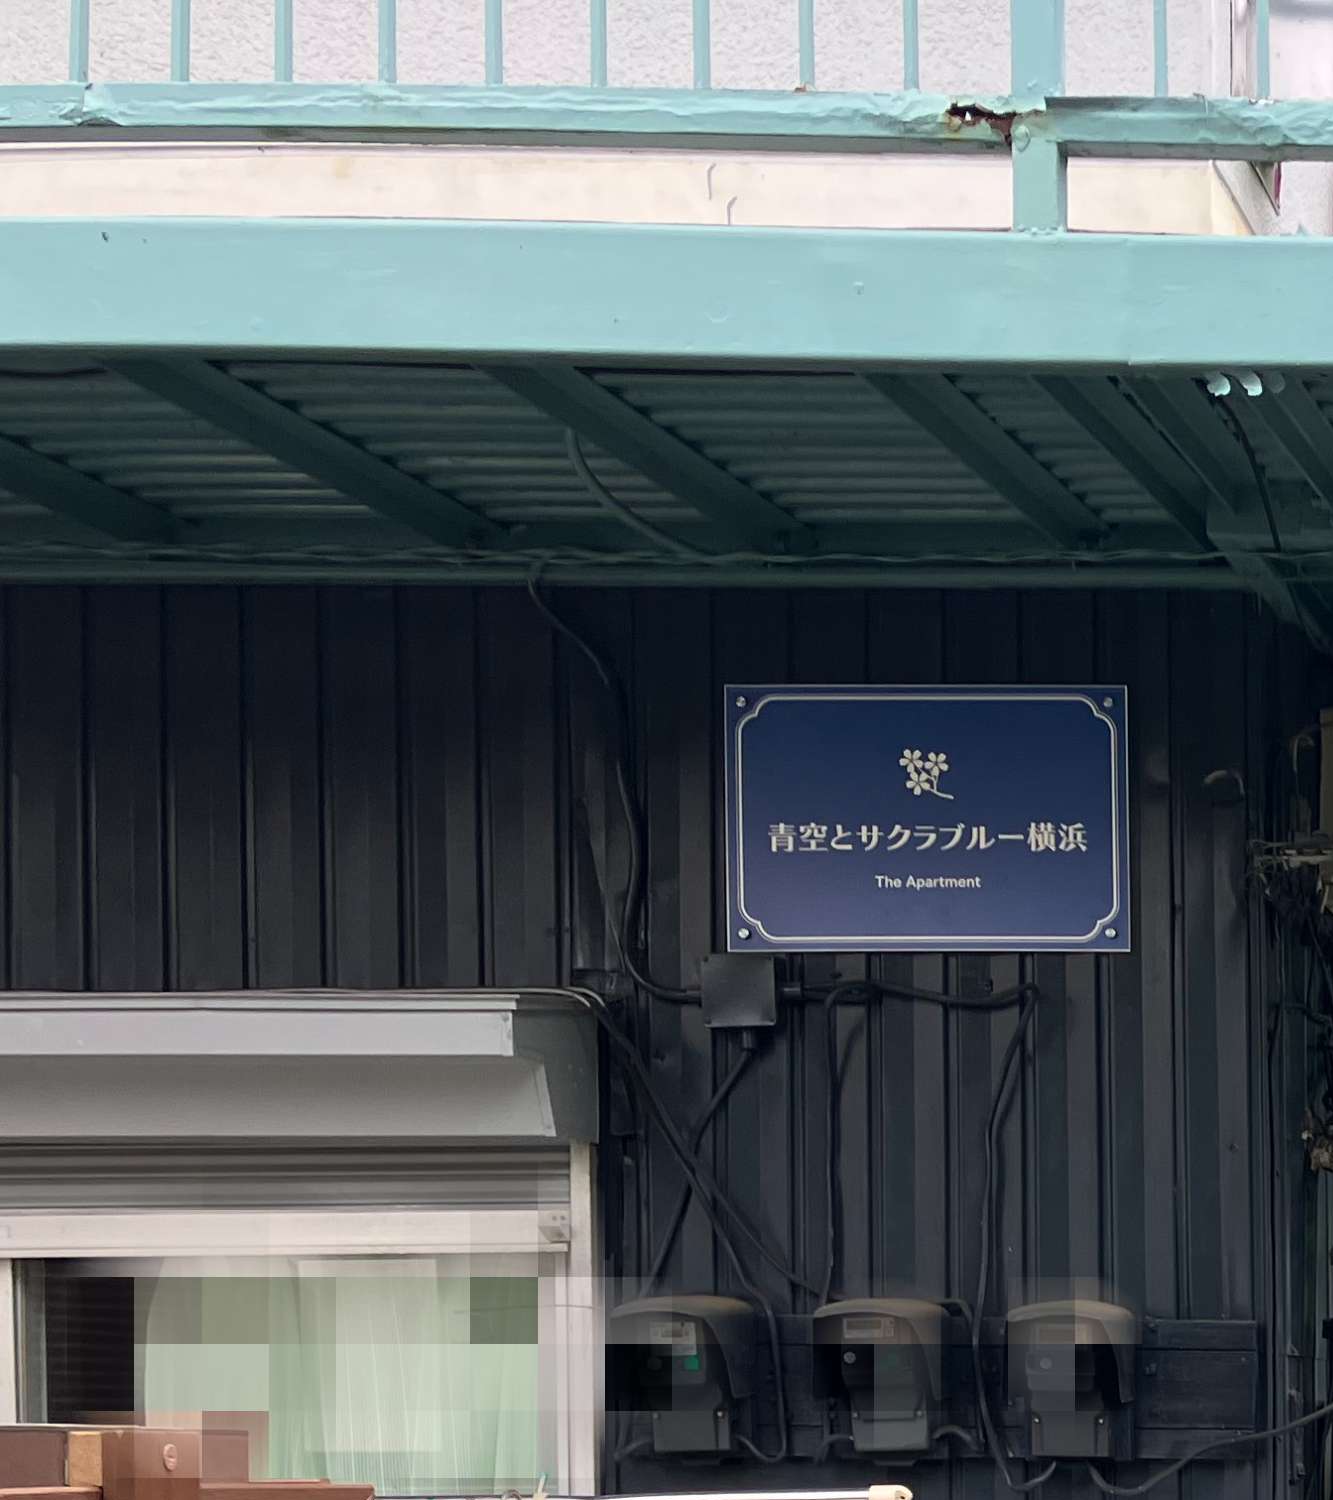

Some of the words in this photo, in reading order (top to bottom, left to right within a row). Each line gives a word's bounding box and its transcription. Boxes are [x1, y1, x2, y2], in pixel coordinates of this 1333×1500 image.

[768, 822, 1088, 852] 青空とサクラブルー横浜
[875, 874, 902, 889] The
[906, 874, 982, 890] Apartment
